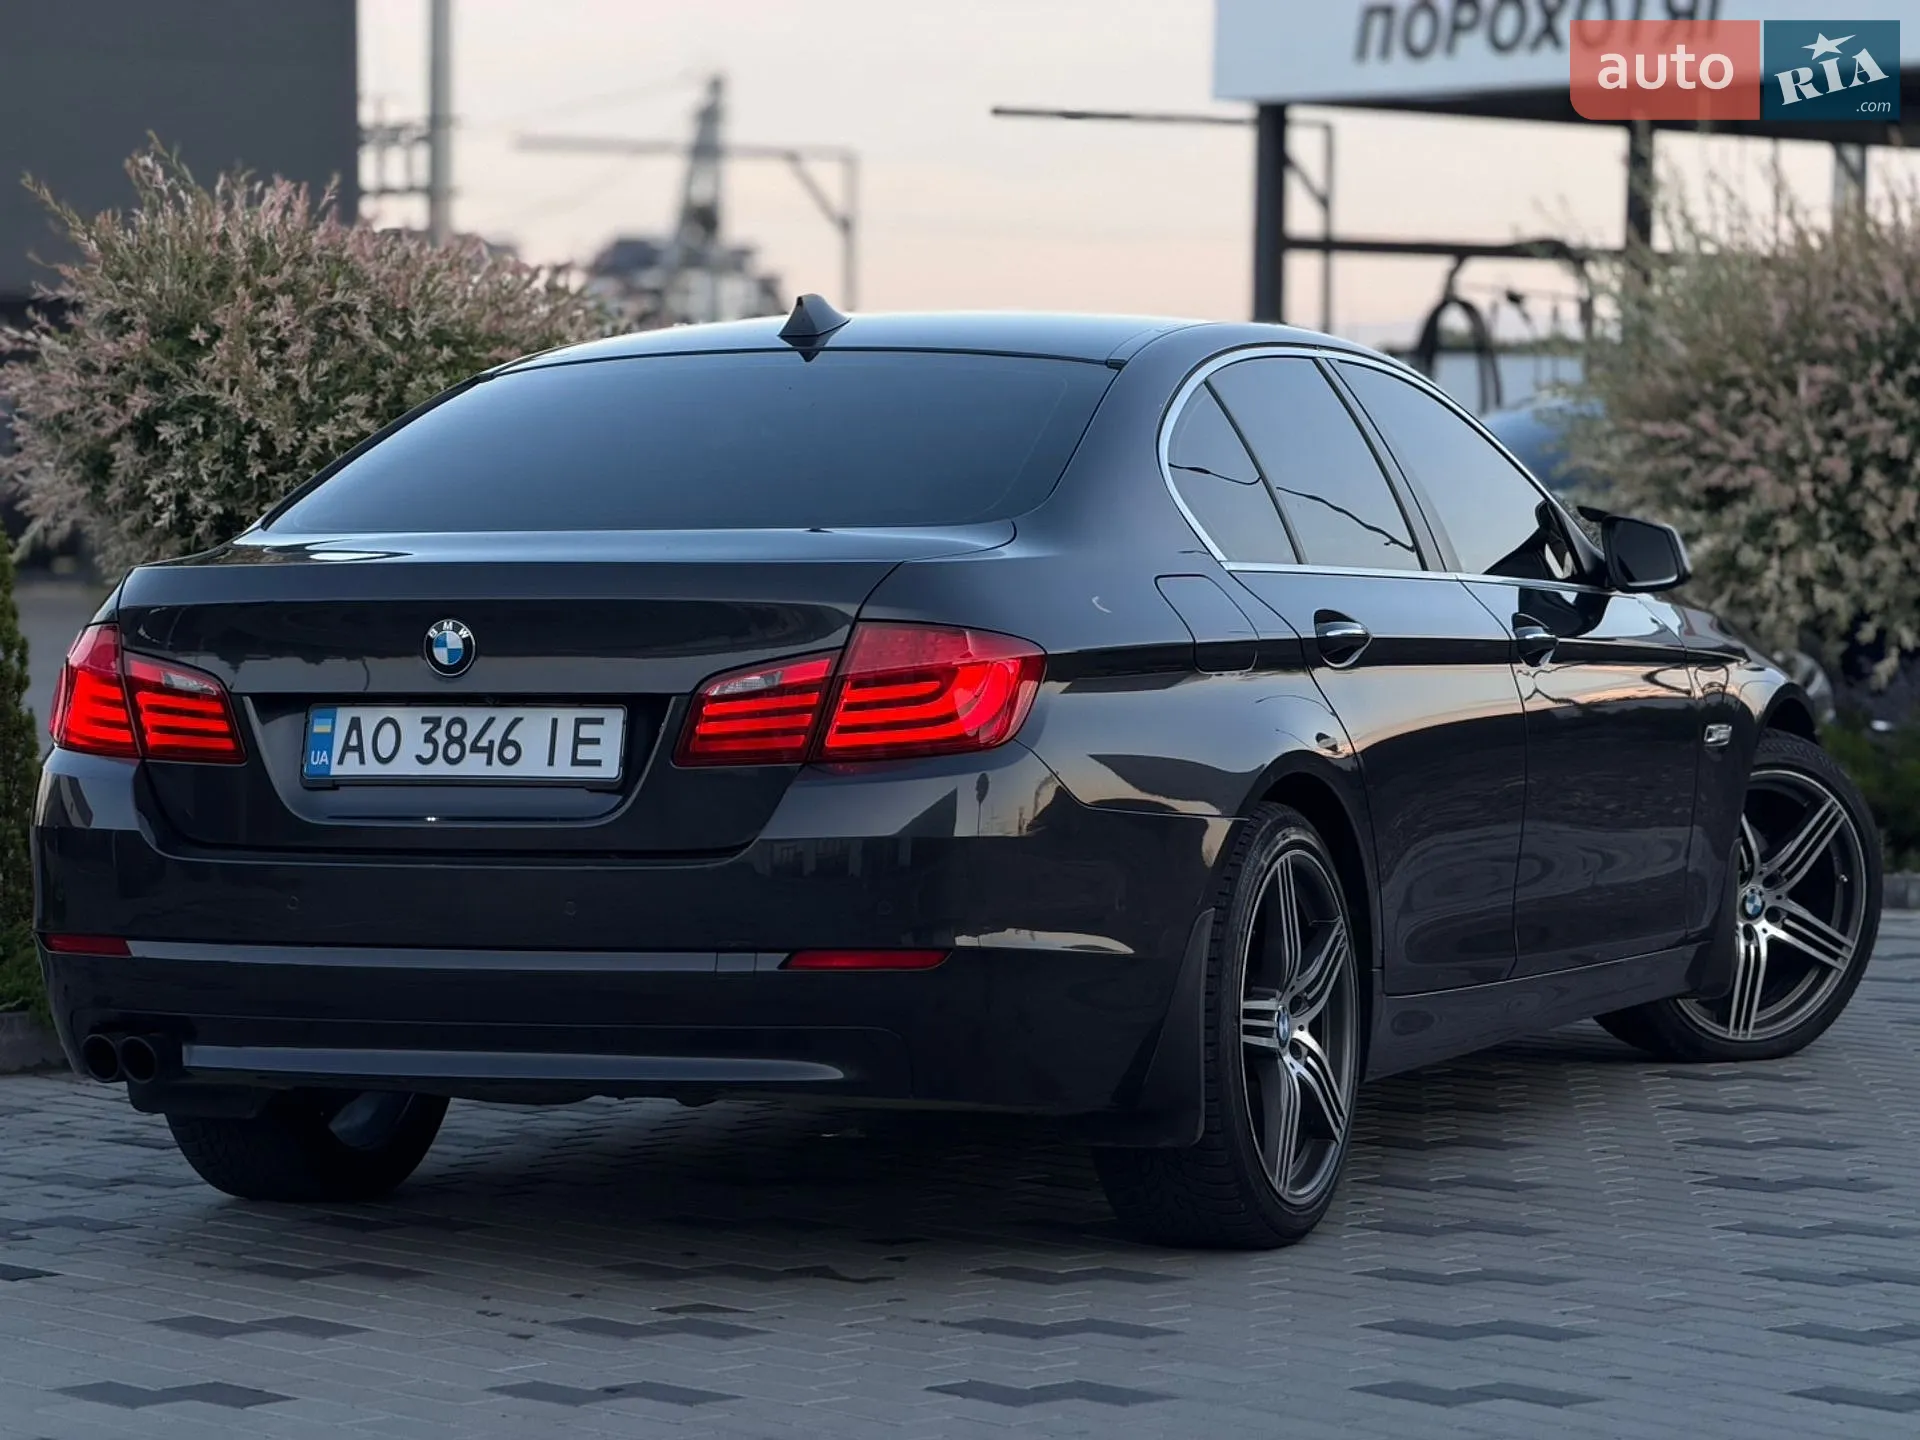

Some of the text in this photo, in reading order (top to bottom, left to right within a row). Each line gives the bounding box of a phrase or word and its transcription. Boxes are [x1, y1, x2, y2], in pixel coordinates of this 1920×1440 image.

[310, 750, 329, 766] UA
[337, 716, 605, 767] AO 3846 IE
